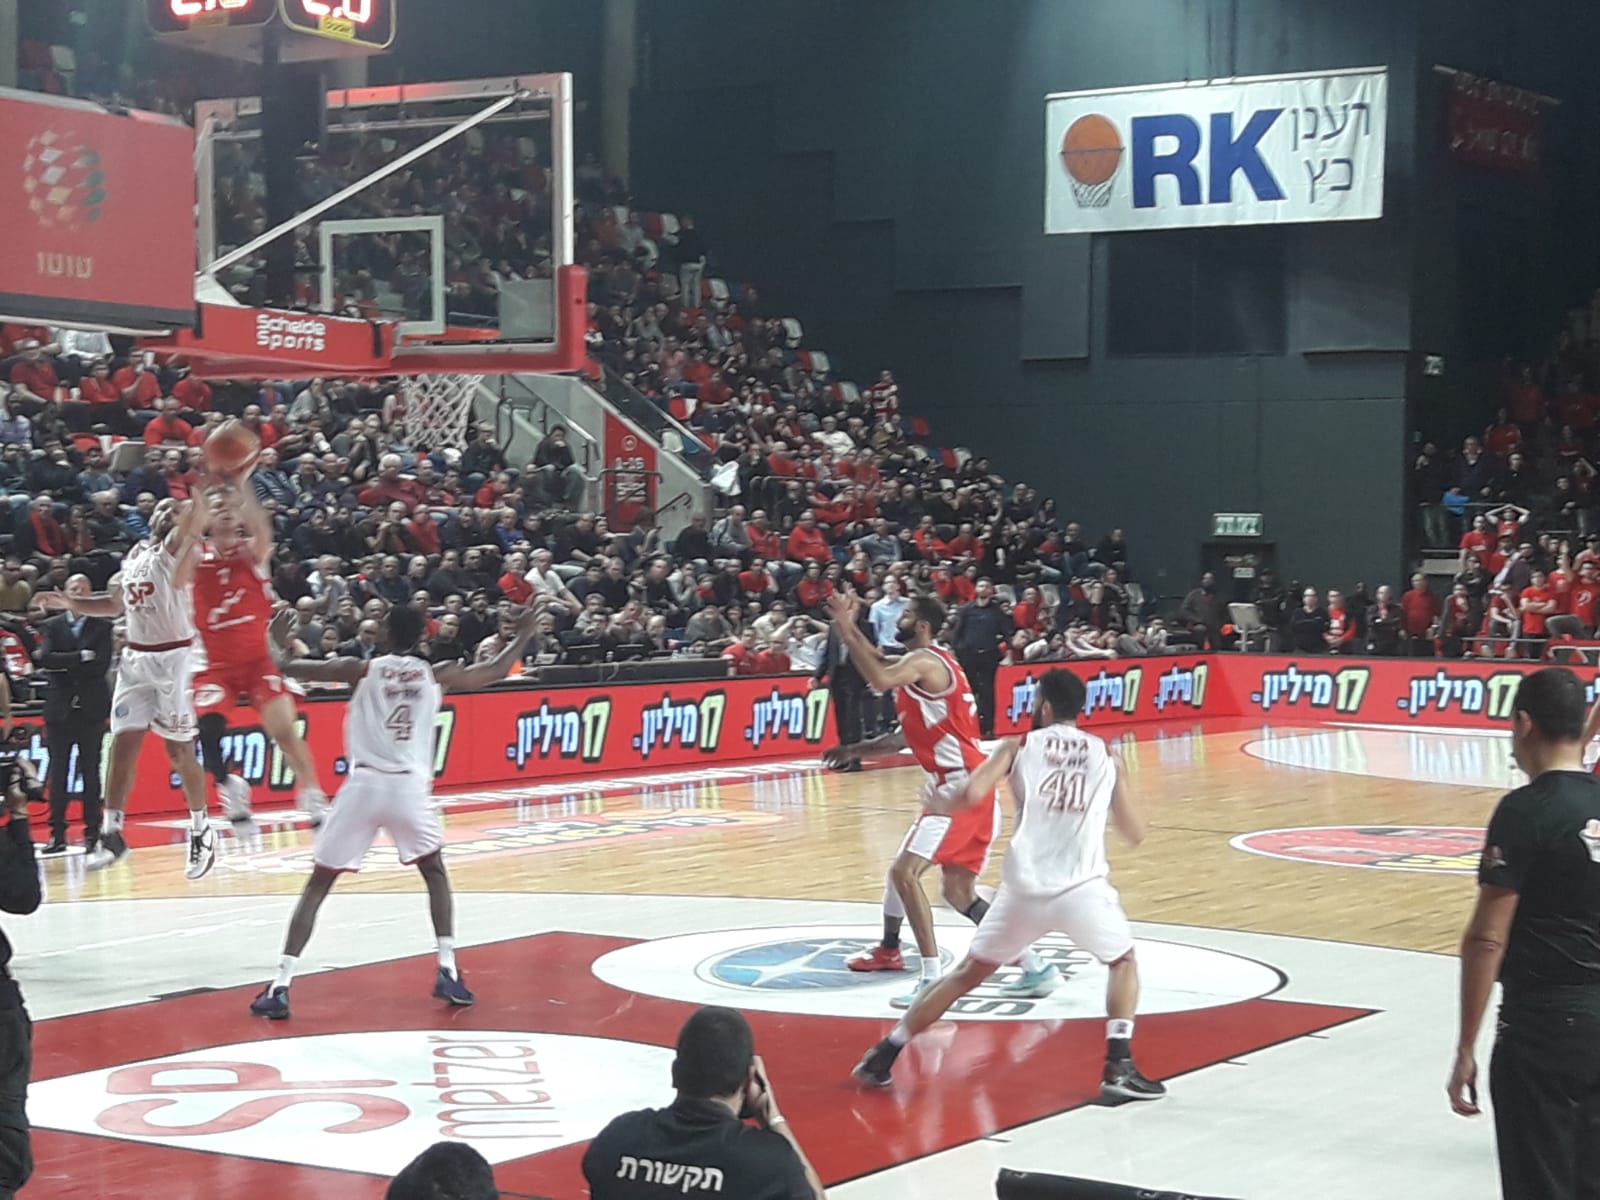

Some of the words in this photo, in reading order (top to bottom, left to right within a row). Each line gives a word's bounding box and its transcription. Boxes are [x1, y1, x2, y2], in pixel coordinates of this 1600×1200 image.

[1290, 101, 1370, 151] רענן
[1131, 107, 1288, 209] RK
[1304, 157, 1352, 204] כץ
[256, 314, 326, 336] Schelde
[256, 330, 326, 352] Sports
[1124, 669, 1142, 712] 17
[1336, 669, 1369, 711] 17
[1487, 674, 1522, 718] 17
[386, 704, 412, 741] 4
[582, 701, 611, 758] 17
[700, 694, 725, 748] 17
[806, 688, 830, 740] 17
[1039, 768, 1087, 813] 41
[94, 1060, 410, 1138] SP
[410, 1035, 563, 1140] metzer
[616, 1155, 724, 1193] תקשורת
